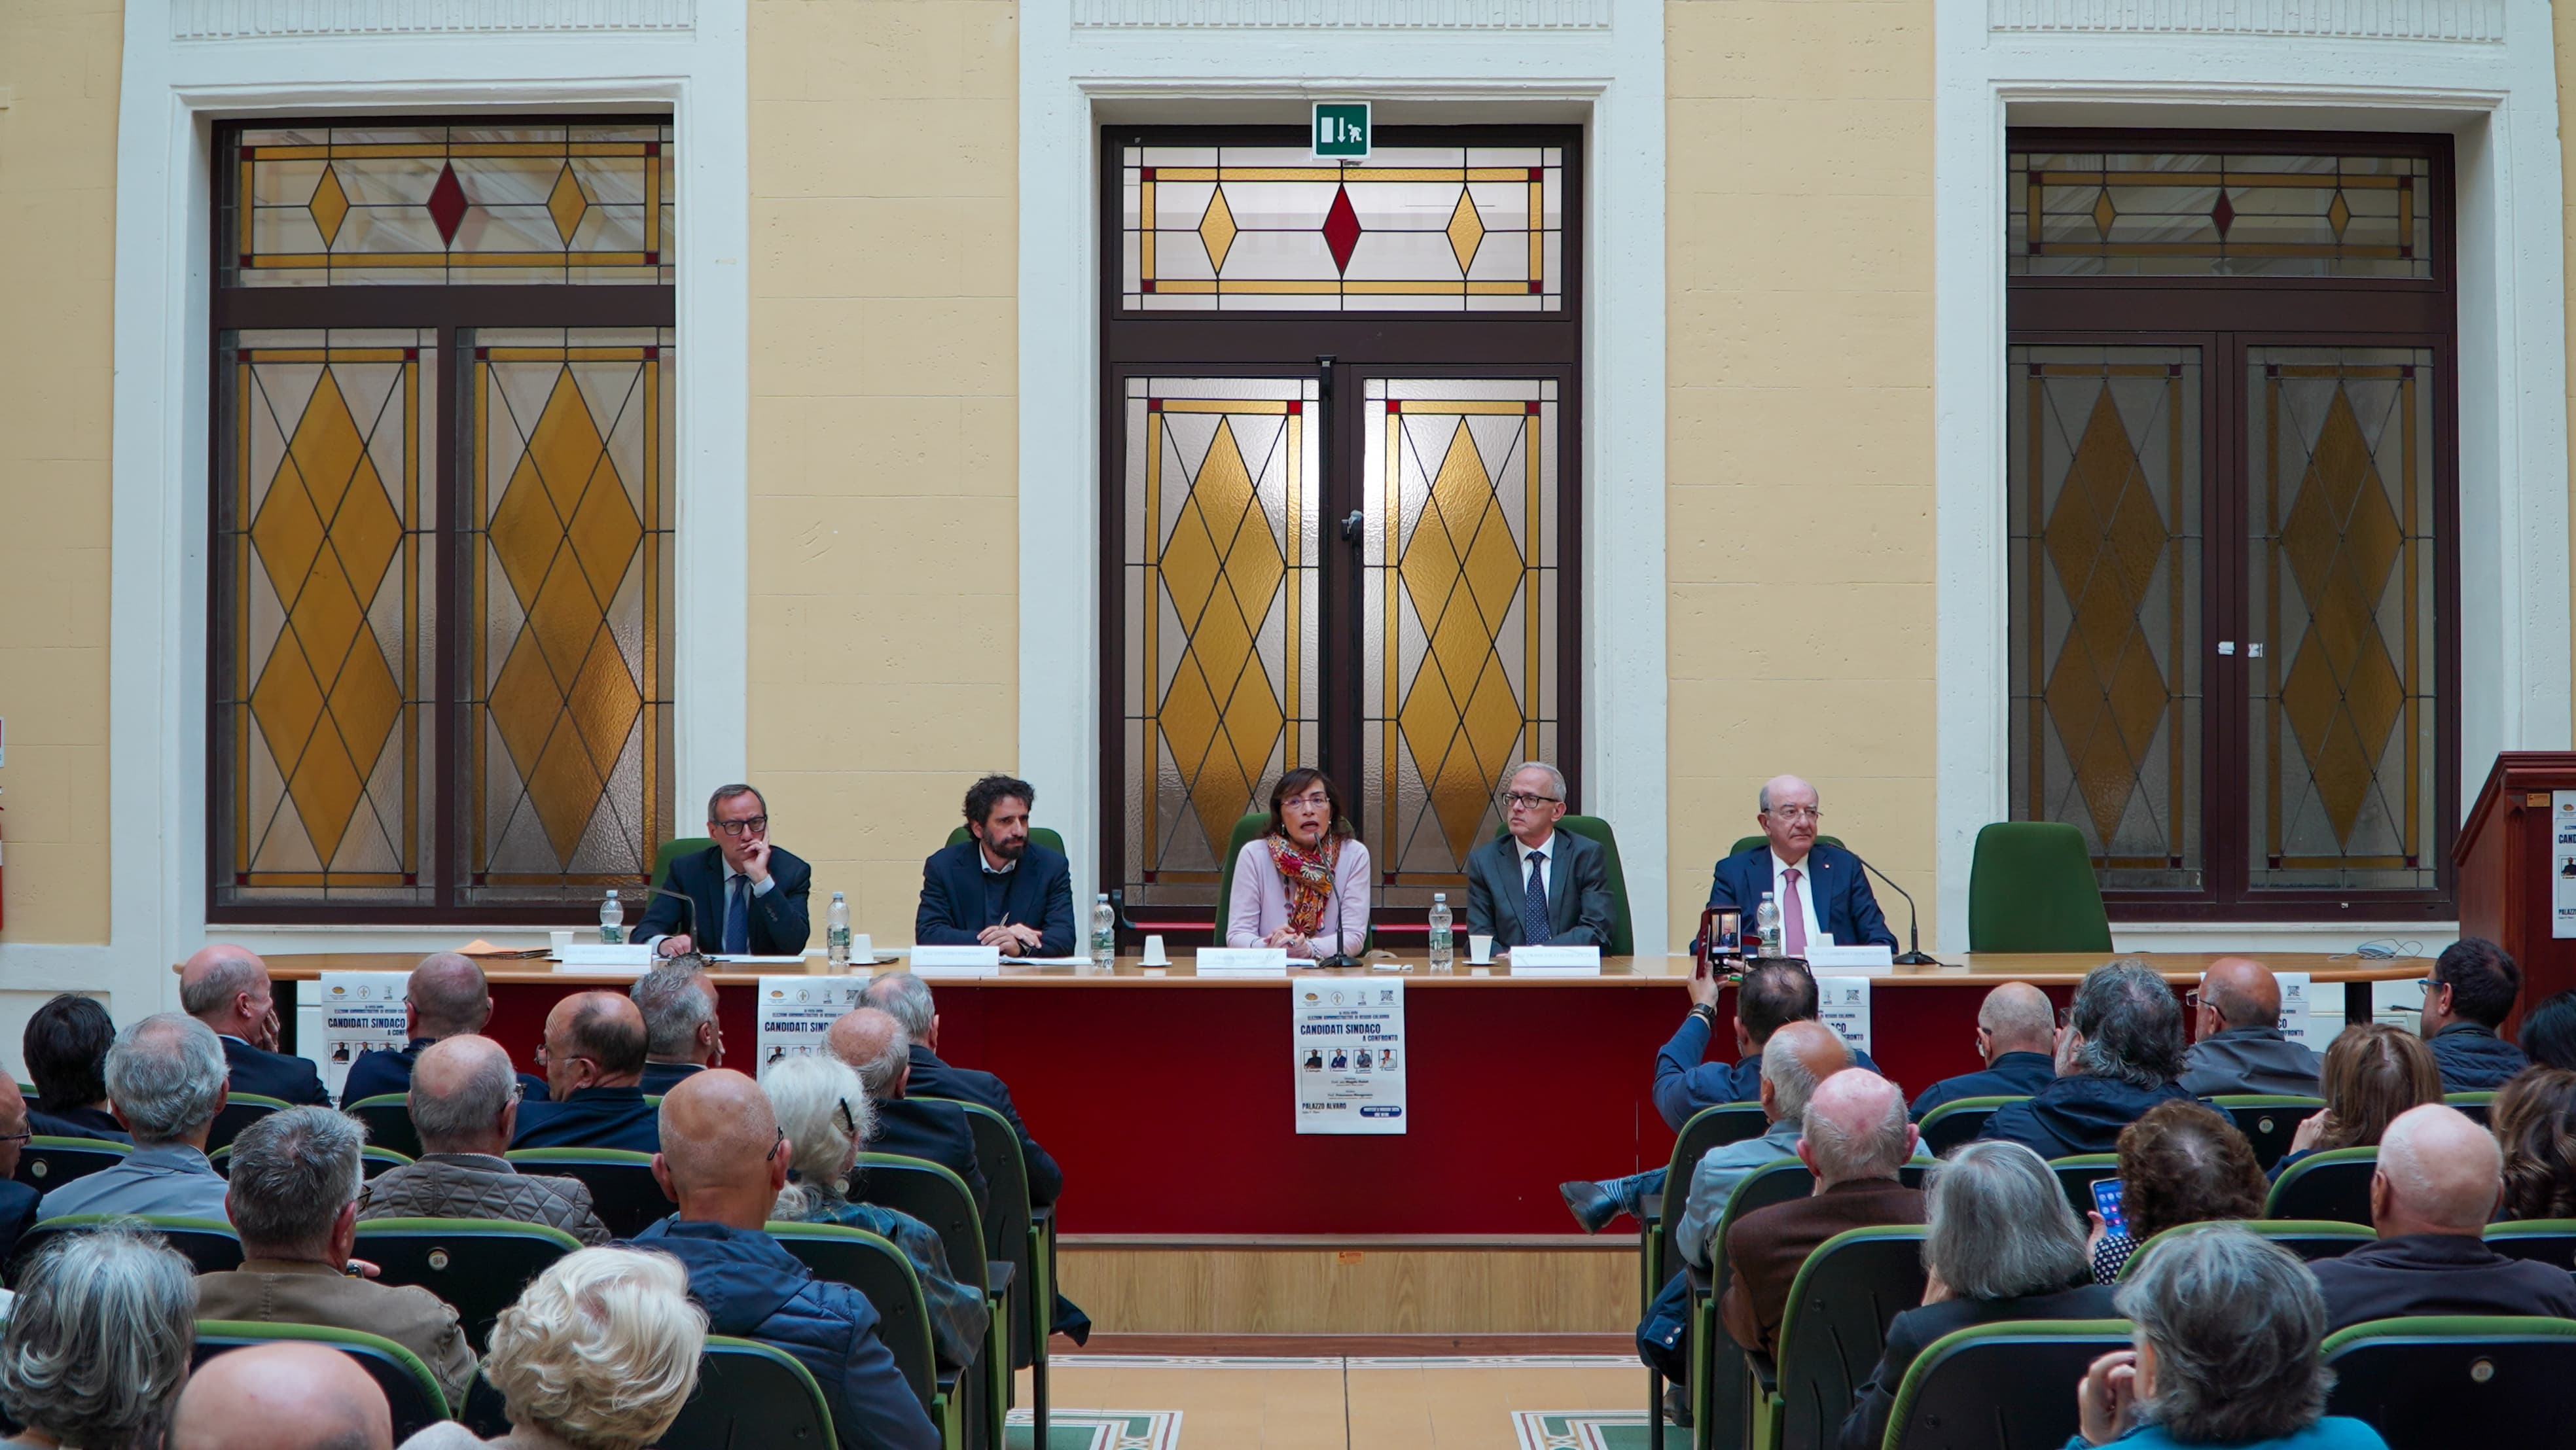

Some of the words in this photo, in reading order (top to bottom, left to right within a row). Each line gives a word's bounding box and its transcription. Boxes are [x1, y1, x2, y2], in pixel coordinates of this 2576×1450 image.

[2559, 834, 2576, 844] CAND
[328, 1018, 368, 1028] CANDIDATI
[371, 1017, 406, 1028] SINDACO
[765, 1022, 807, 1033] CANDIDATI
[1300, 1024, 1343, 1035] CANDIDATI
[1346, 1023, 1381, 1034] SINDACO
